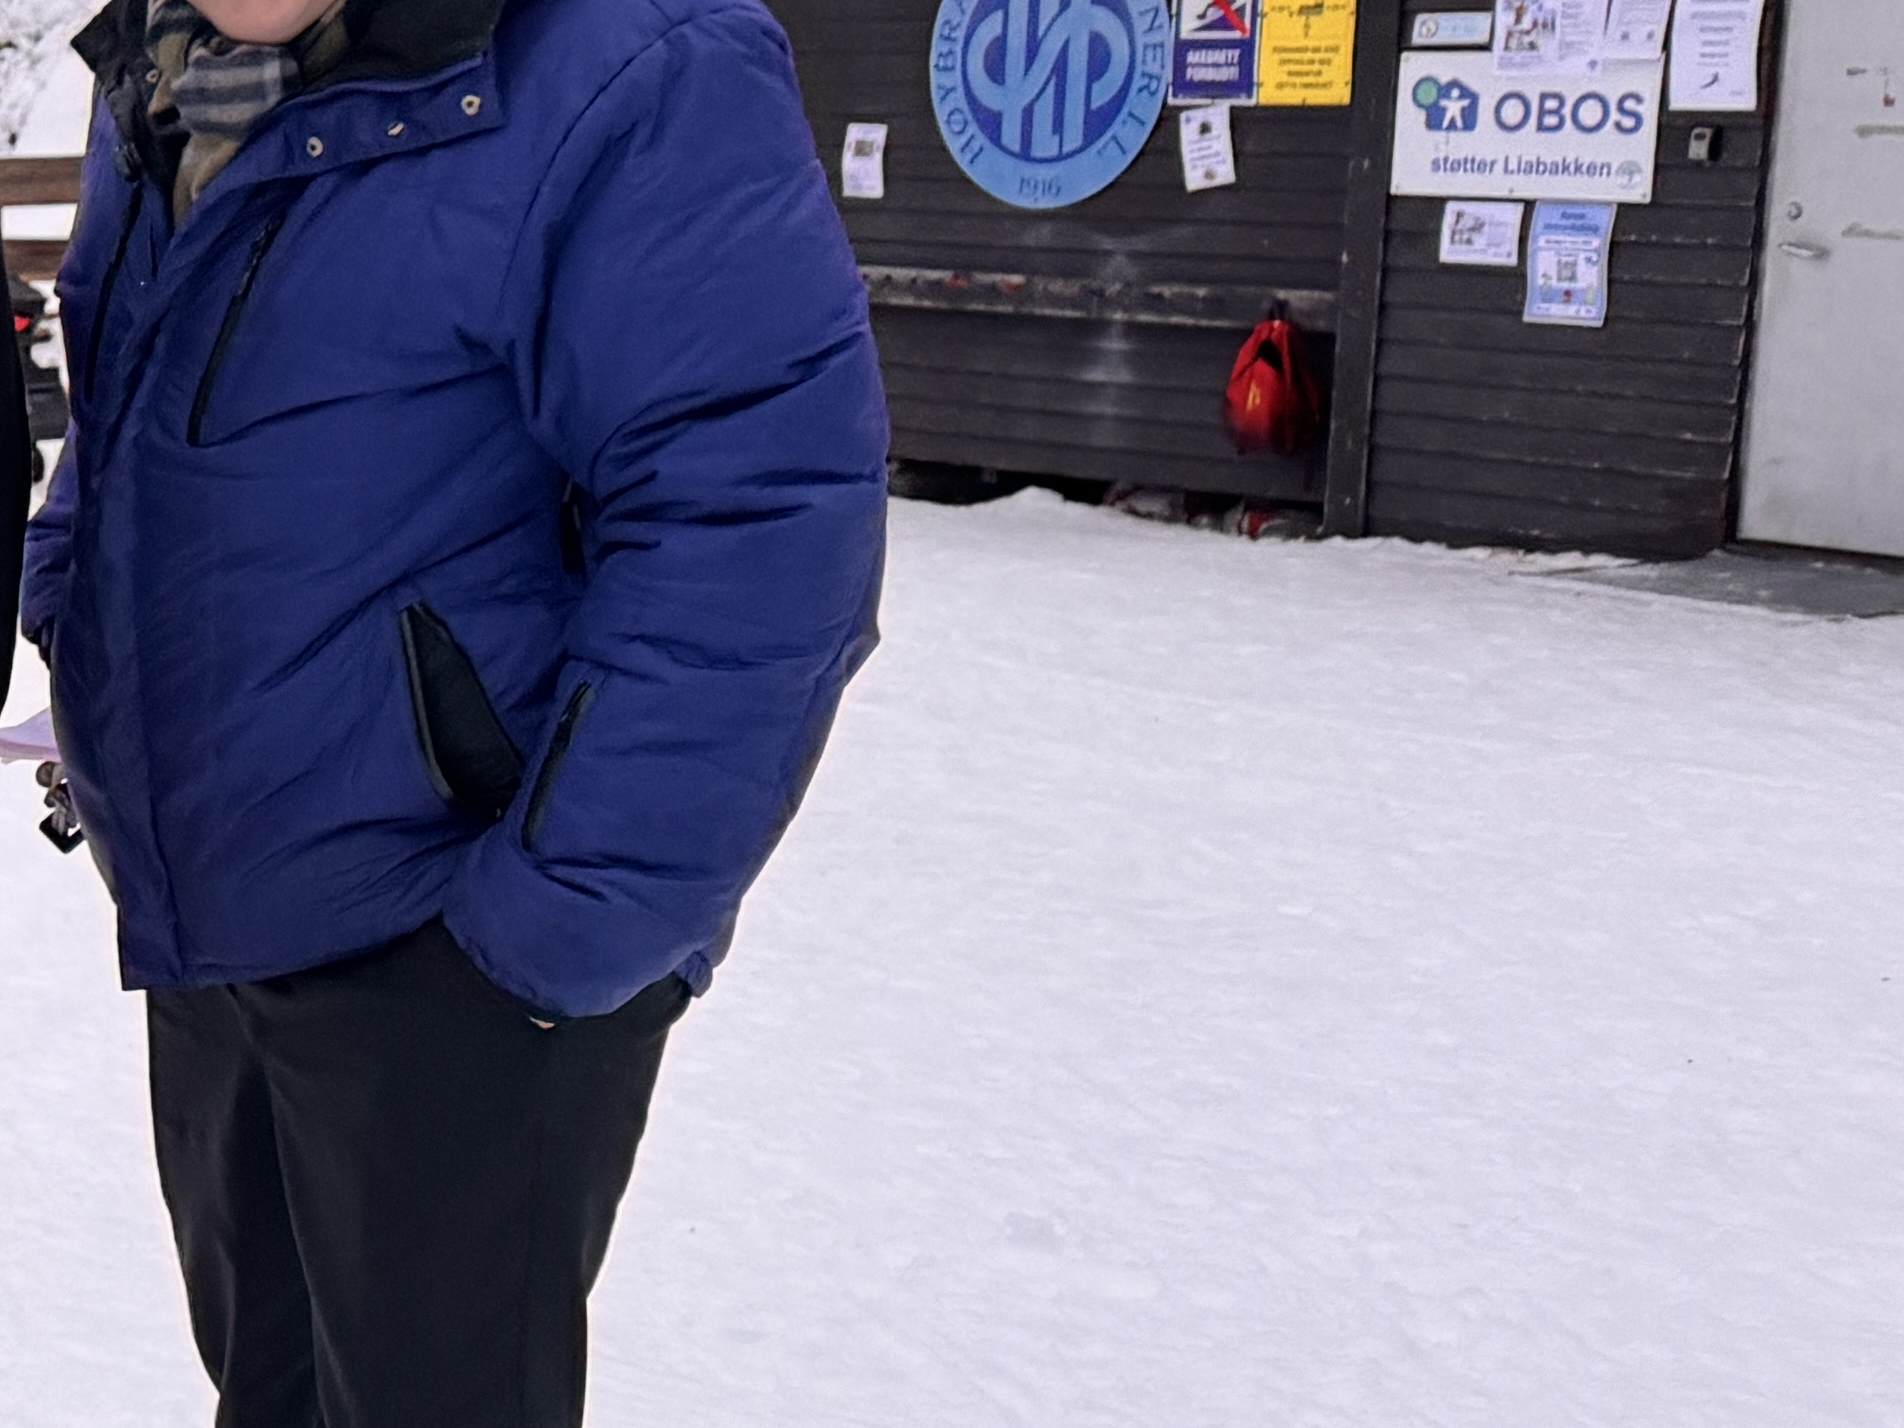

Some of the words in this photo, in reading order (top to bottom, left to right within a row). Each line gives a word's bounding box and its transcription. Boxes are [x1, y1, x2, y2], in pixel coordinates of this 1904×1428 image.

[1494, 91, 1644, 134] OBOS
[1430, 155, 1498, 176] støtter
[1503, 155, 1612, 178] Liabakken
